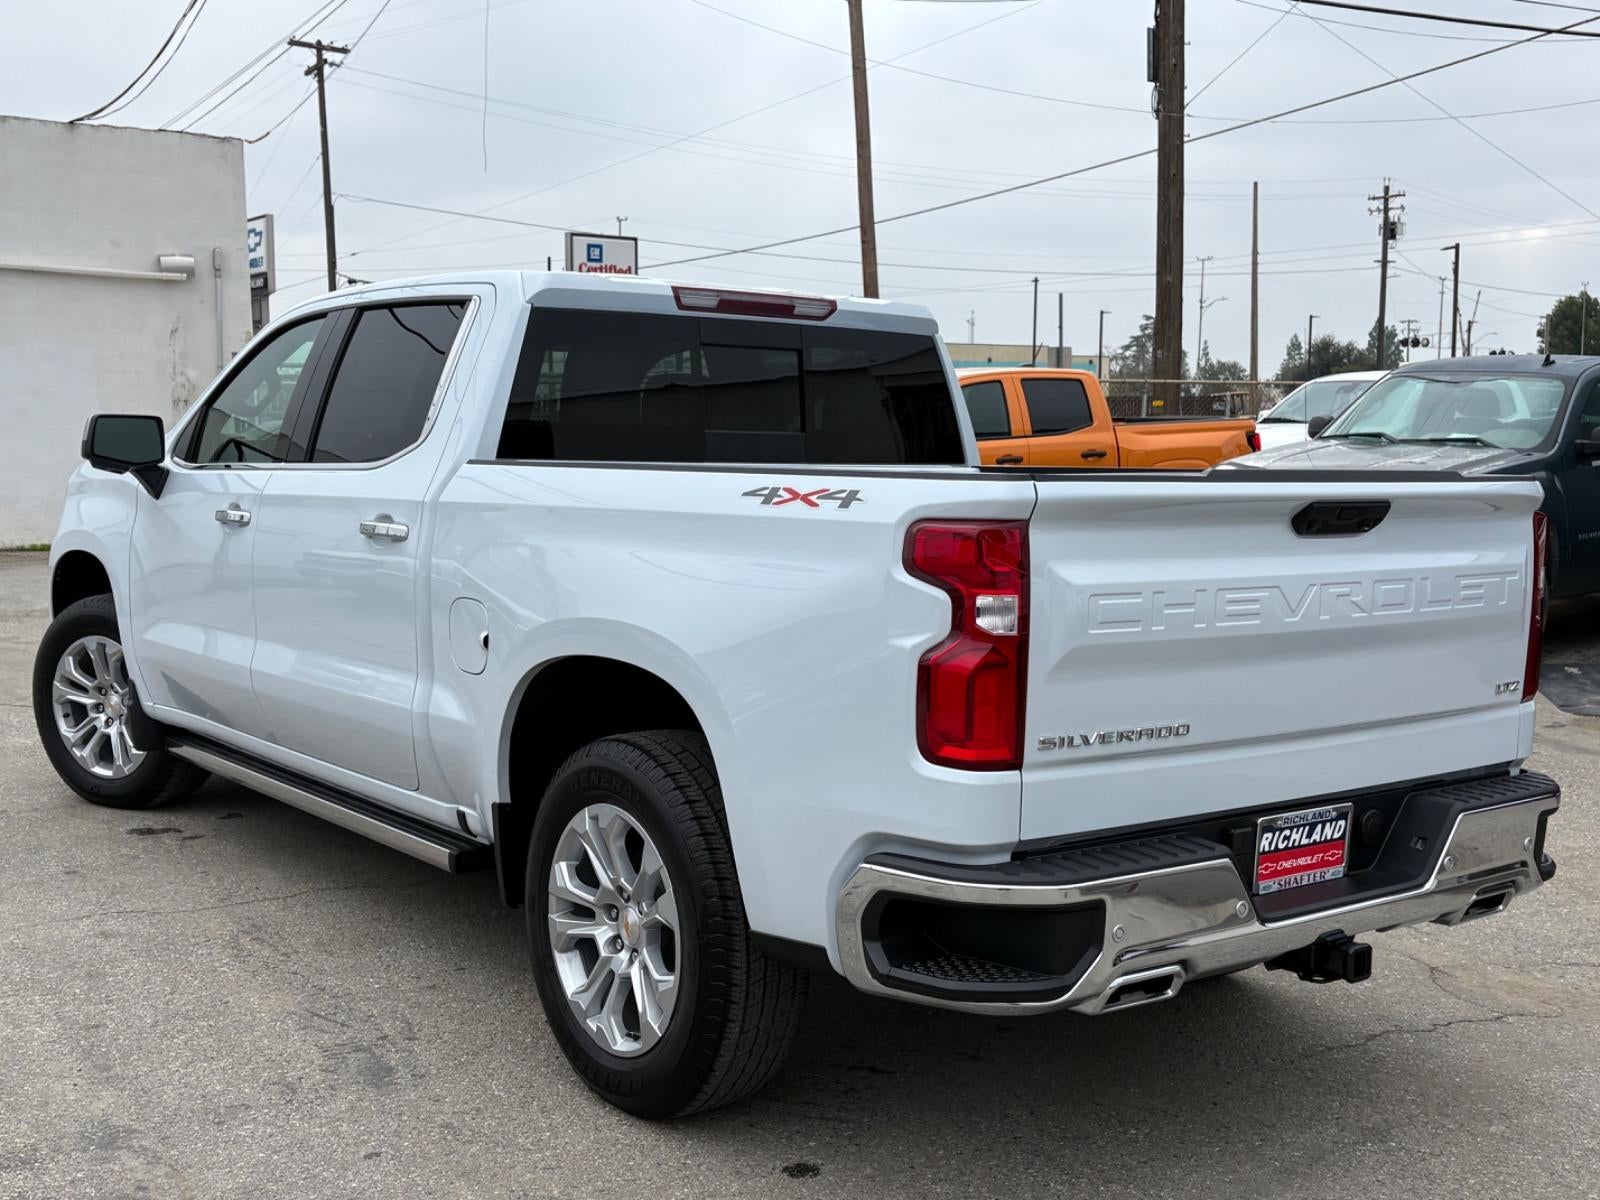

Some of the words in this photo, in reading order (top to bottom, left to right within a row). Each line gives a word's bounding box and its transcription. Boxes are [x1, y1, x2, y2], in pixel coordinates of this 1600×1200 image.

[578, 262, 632, 275] Certified
[1087, 571, 1519, 634] CHEVROLET
[1495, 680, 1520, 696] LTZ
[1037, 723, 1191, 751] SILVERADO
[570, 770, 640, 804] GENERAL
[1283, 810, 1332, 827] RICHLAND
[1260, 820, 1346, 852] RICHLAND
[1276, 853, 1325, 870] CHEVROLET
